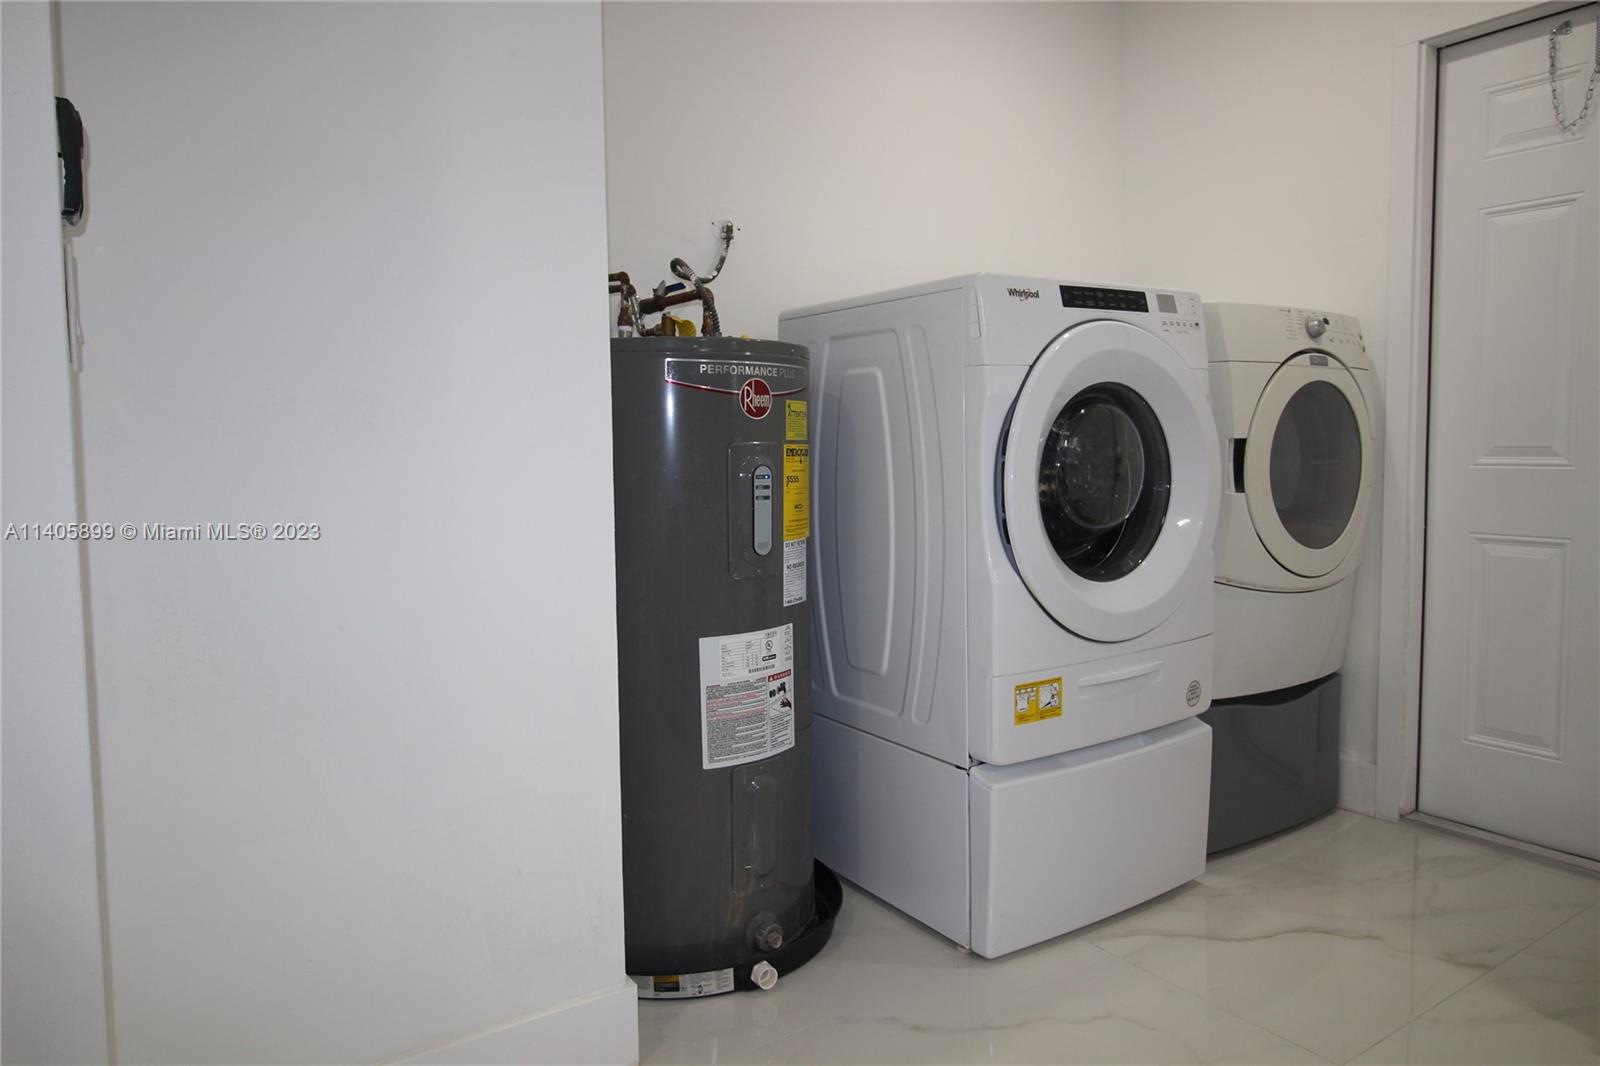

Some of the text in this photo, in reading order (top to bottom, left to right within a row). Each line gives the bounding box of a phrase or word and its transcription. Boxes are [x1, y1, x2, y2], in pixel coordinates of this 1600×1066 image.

[1007, 287, 1040, 299] Whirlpool
[700, 364, 796, 378] PERFORMANCE PLUS
[744, 380, 770, 412] Rheem
